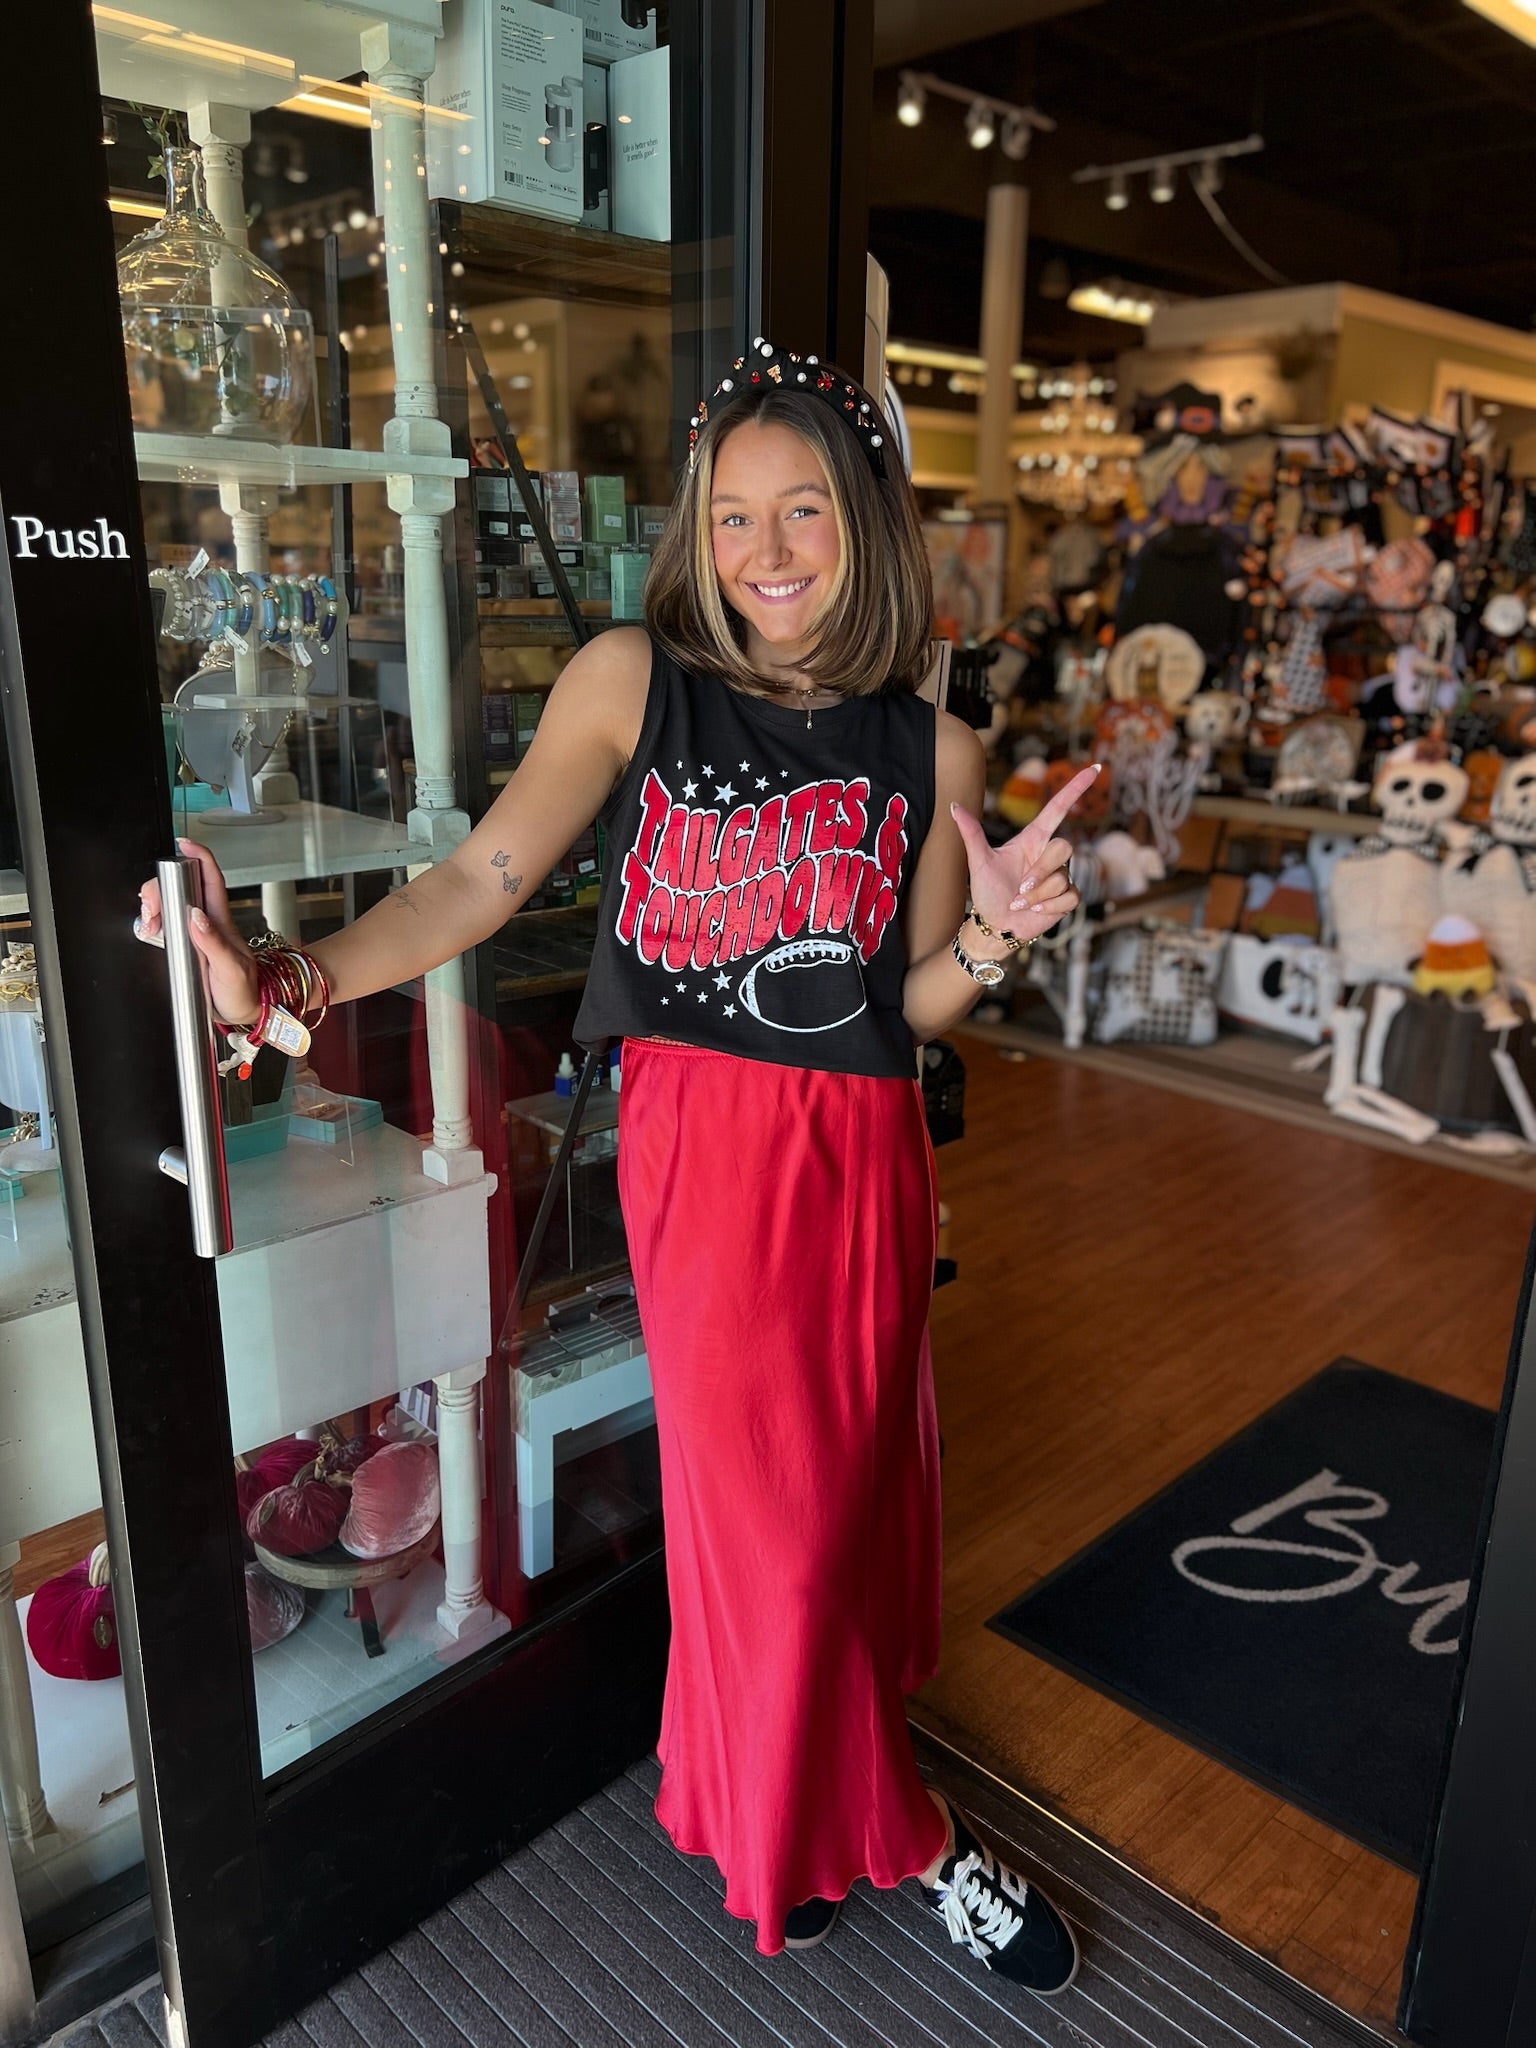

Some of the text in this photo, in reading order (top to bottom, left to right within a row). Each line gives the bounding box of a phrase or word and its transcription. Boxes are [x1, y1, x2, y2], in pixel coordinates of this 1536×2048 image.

[10, 515, 131, 559] Push
[636, 768, 870, 892] TAILGATES
[615, 850, 898, 974] TOUCHDOWNS
